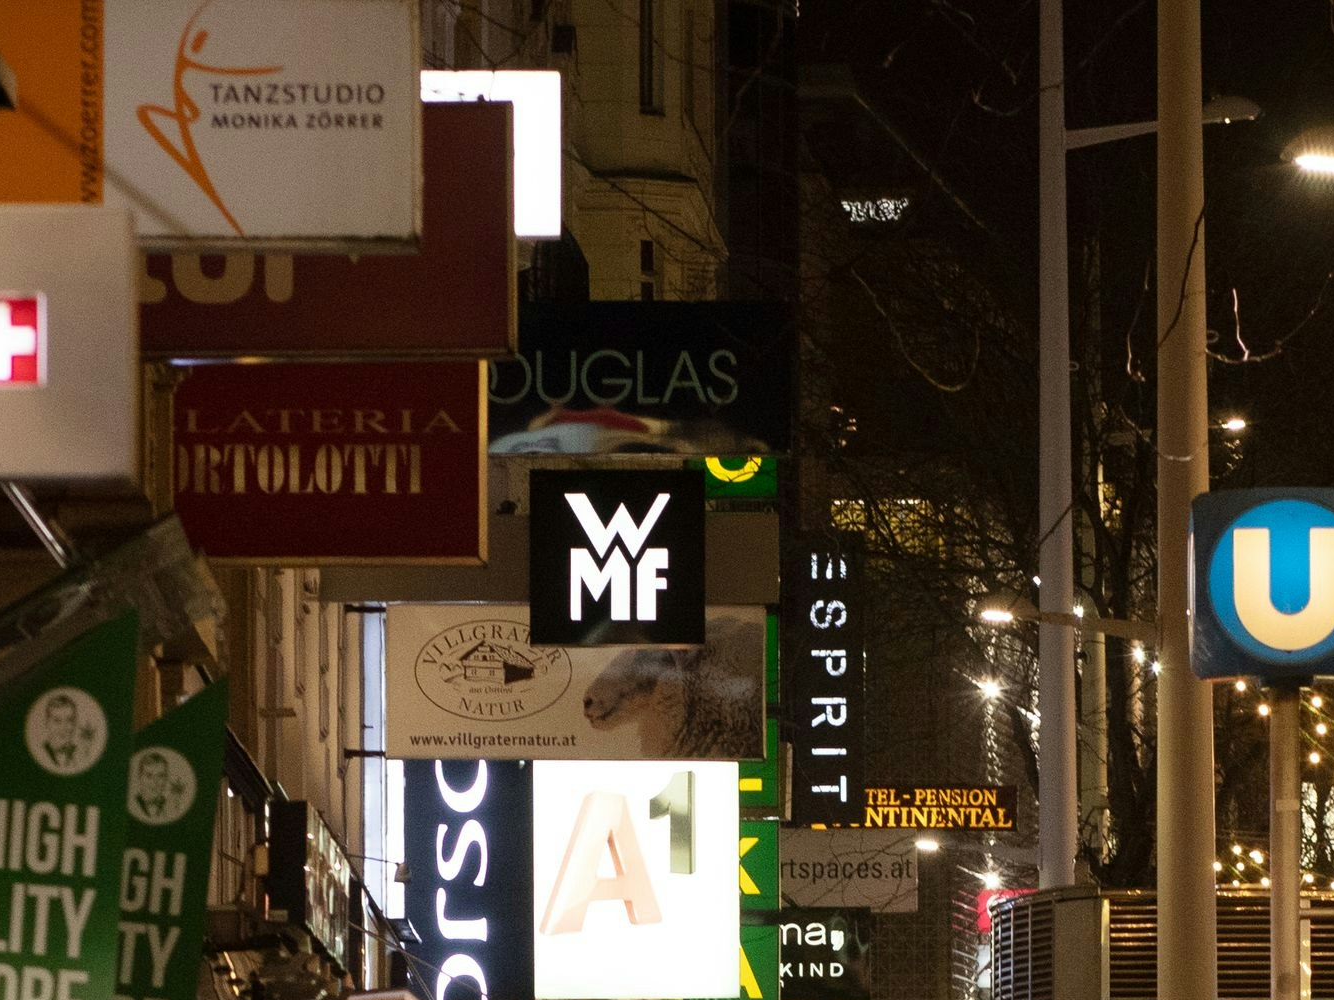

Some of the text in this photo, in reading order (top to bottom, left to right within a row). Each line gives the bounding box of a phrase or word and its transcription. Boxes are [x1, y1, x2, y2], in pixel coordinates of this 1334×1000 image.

[210, 82, 386, 107] TANZSTUDIO
[210, 109, 385, 130] MONIKA ZÖRRER
[489, 350, 739, 405] OUGLAS
[179, 408, 465, 434] LATERIA
[564, 492, 671, 622] WMF
[422, 624, 563, 665] VILLGRATR
[810, 552, 848, 803] ESPRIT
[458, 697, 525, 716] NATUR
[410, 732, 577, 749] www.villgraternatur.at
[914, 789, 998, 807] PENSION
[857, 807, 1013, 829] NTINENTAL
